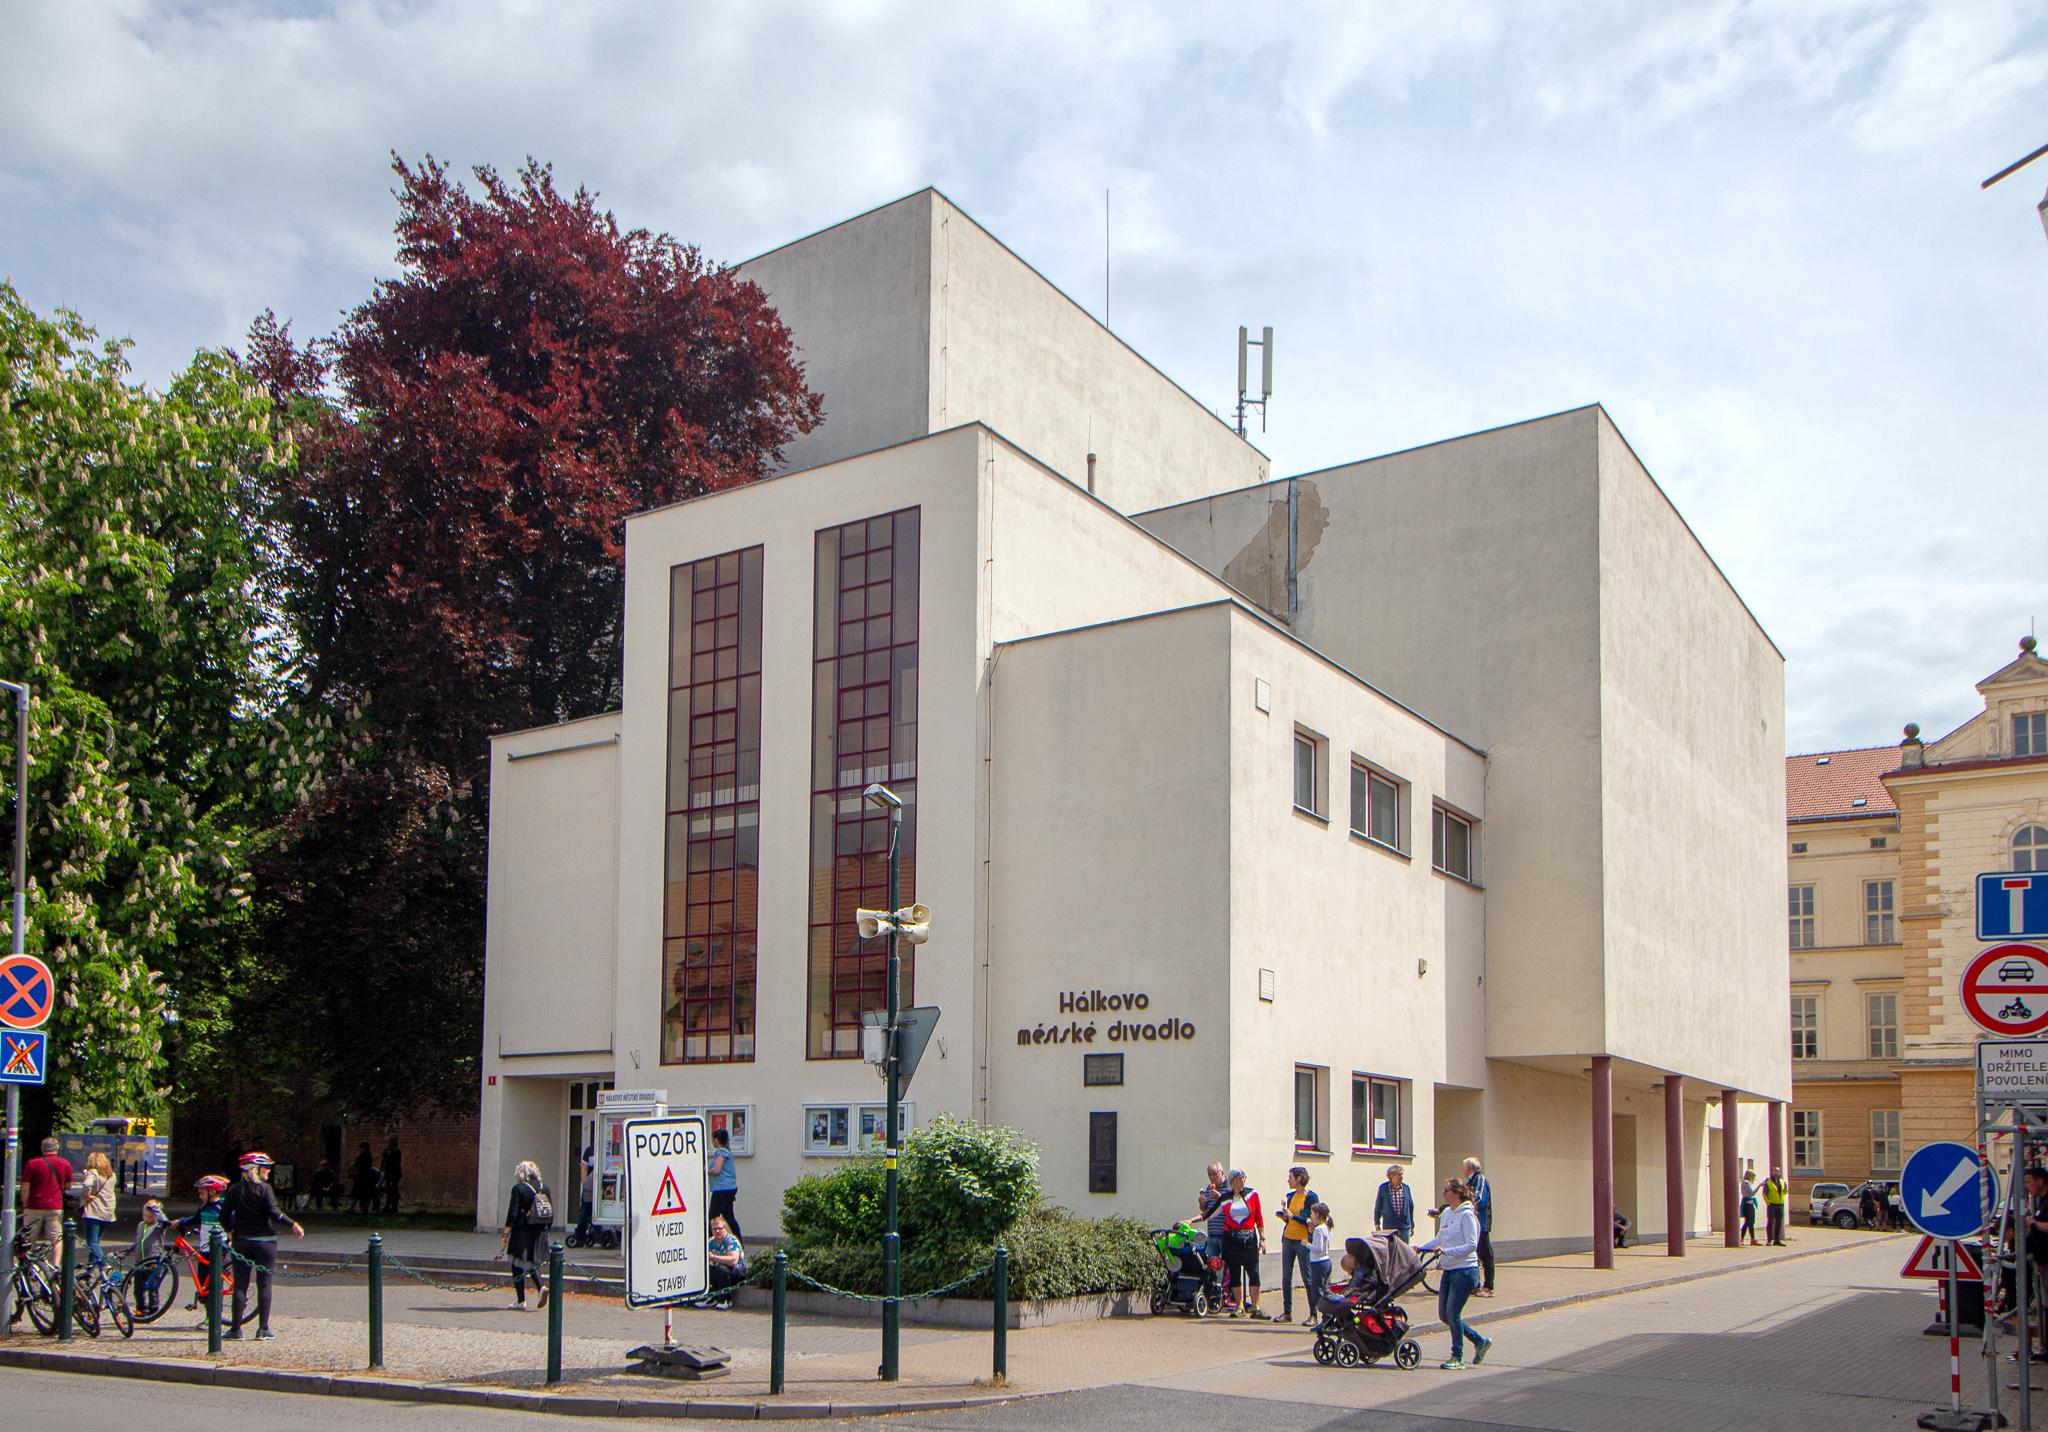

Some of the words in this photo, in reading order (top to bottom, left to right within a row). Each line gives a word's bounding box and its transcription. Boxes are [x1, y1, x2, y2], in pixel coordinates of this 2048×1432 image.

[1059, 990, 1149, 1013] Hálkovo
[1107, 1017, 1195, 1042] divadlo
[1999, 1048, 2033, 1058] MIMO
[1987, 1060, 2047, 1072] DRŽITELE
[635, 1131, 697, 1158] POZOR
[656, 1220, 684, 1238] VÝJEZD
[656, 1247, 688, 1265] VOZIDEL
[657, 1275, 687, 1293] STAVBY
